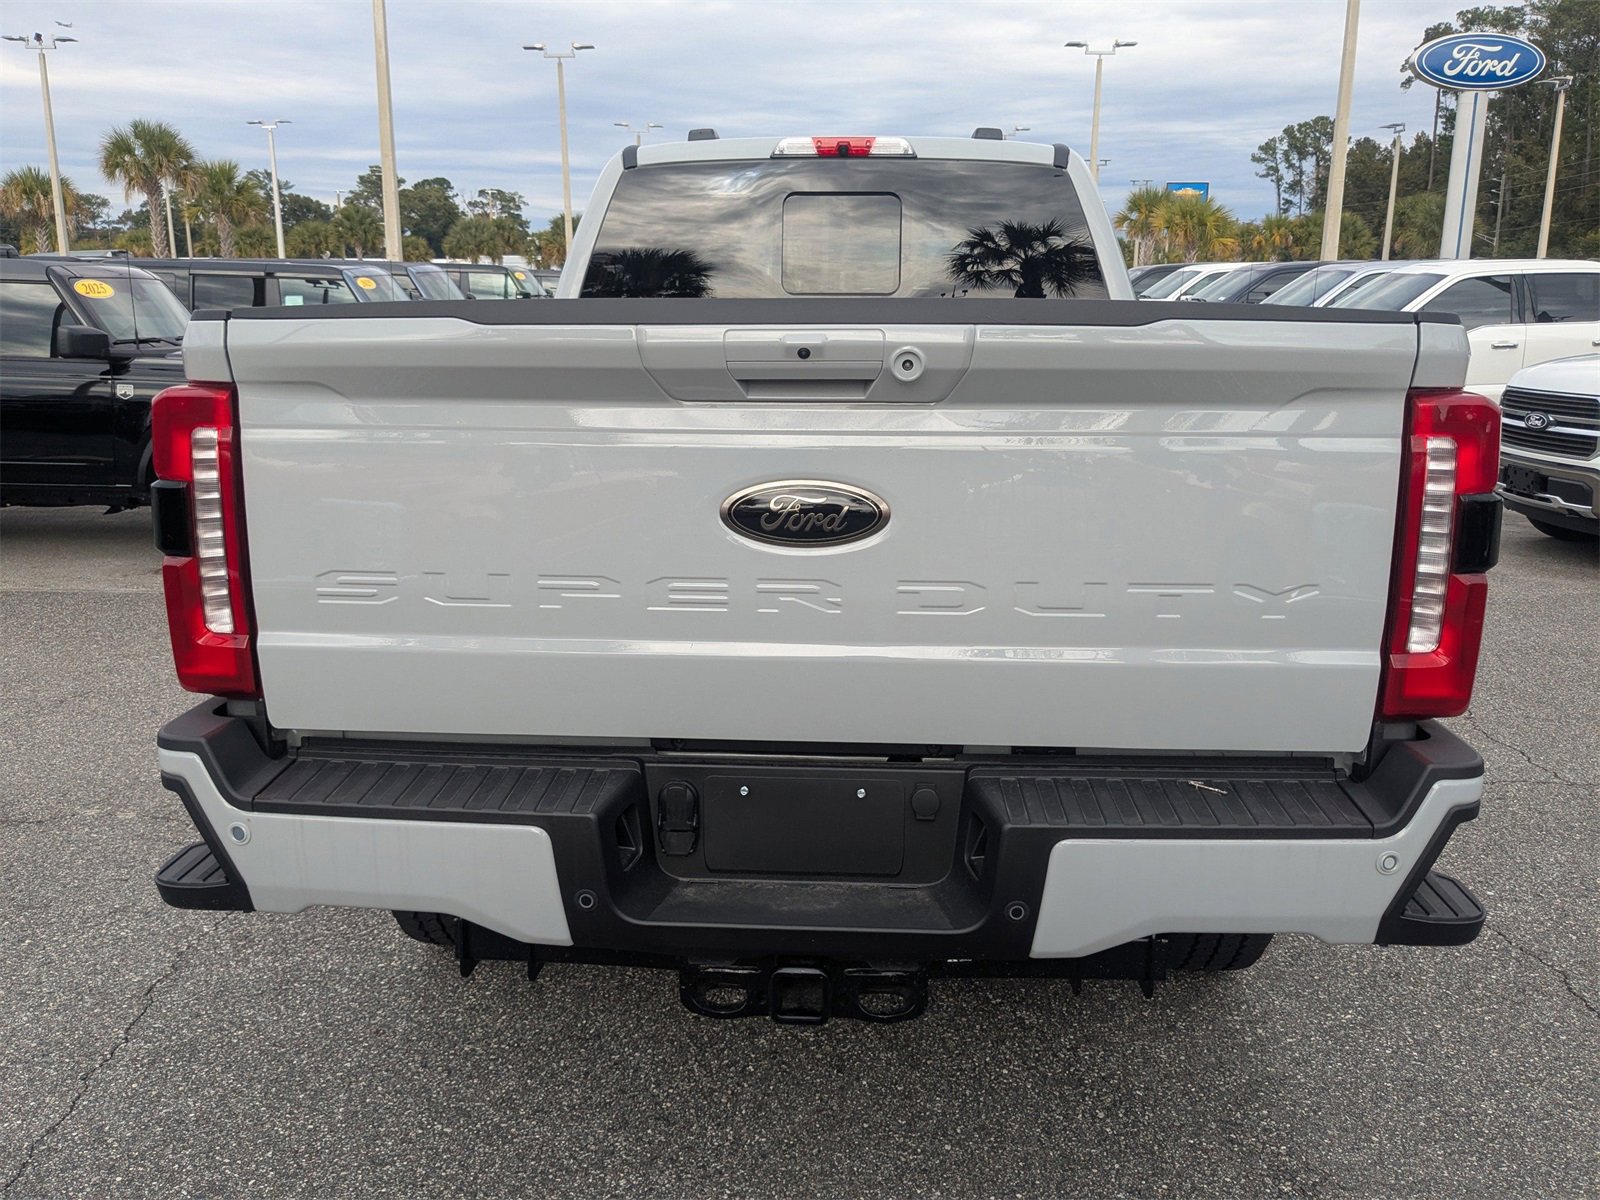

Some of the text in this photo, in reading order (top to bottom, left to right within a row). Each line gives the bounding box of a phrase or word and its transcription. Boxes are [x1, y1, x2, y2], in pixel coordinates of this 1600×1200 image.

[1443, 43, 1521, 77] Ford
[81, 282, 107, 295] 2025
[760, 494, 850, 532] Ford
[315, 569, 1320, 619] SUPER DUTY
